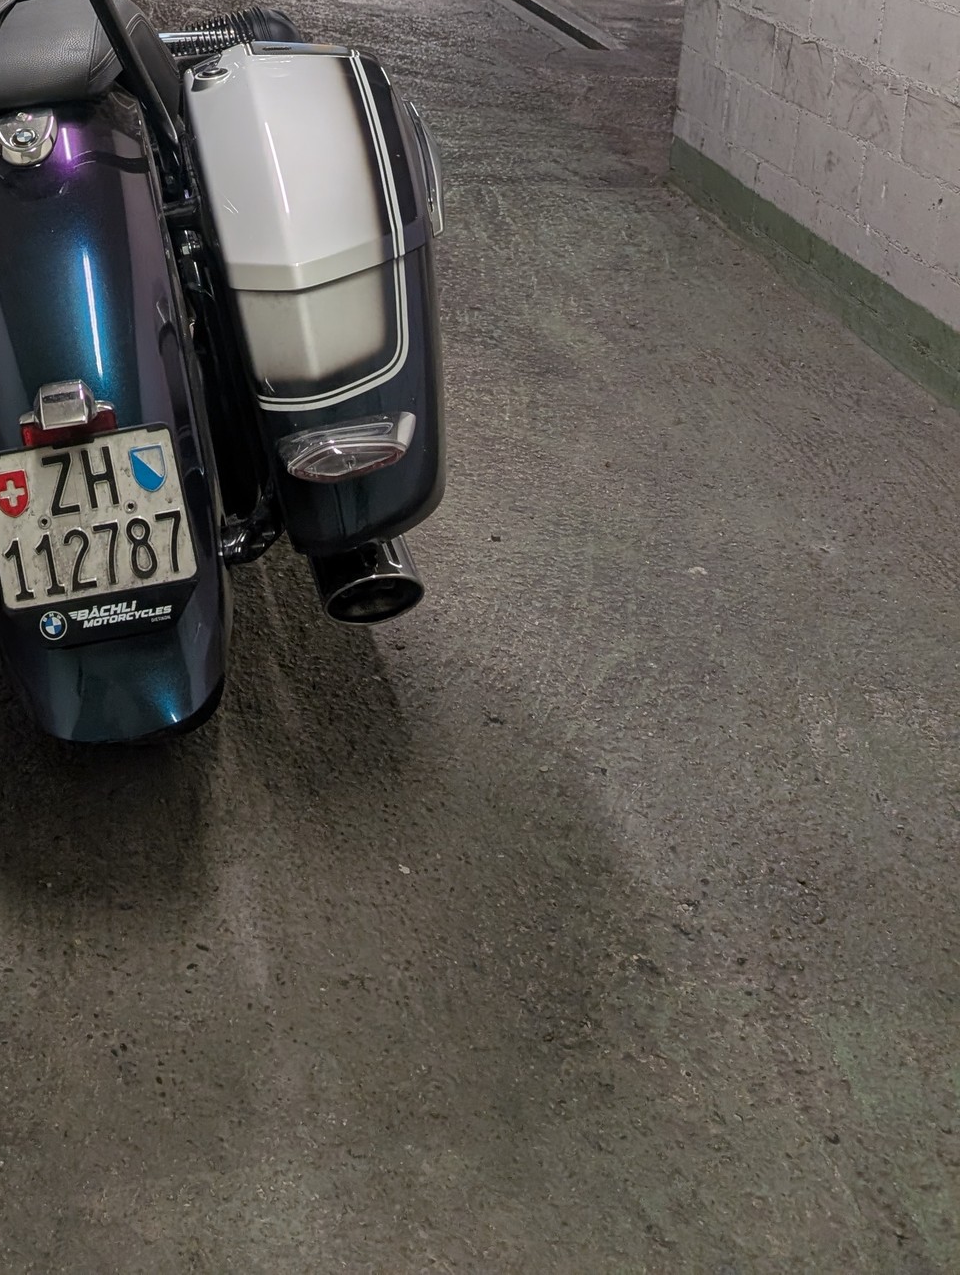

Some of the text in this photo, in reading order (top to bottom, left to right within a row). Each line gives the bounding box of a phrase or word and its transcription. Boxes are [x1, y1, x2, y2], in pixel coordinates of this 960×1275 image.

[42, 446, 120, 517] ZH
[3, 509, 182, 602] 112787
[83, 605, 172, 629] MOTORCYCLES
